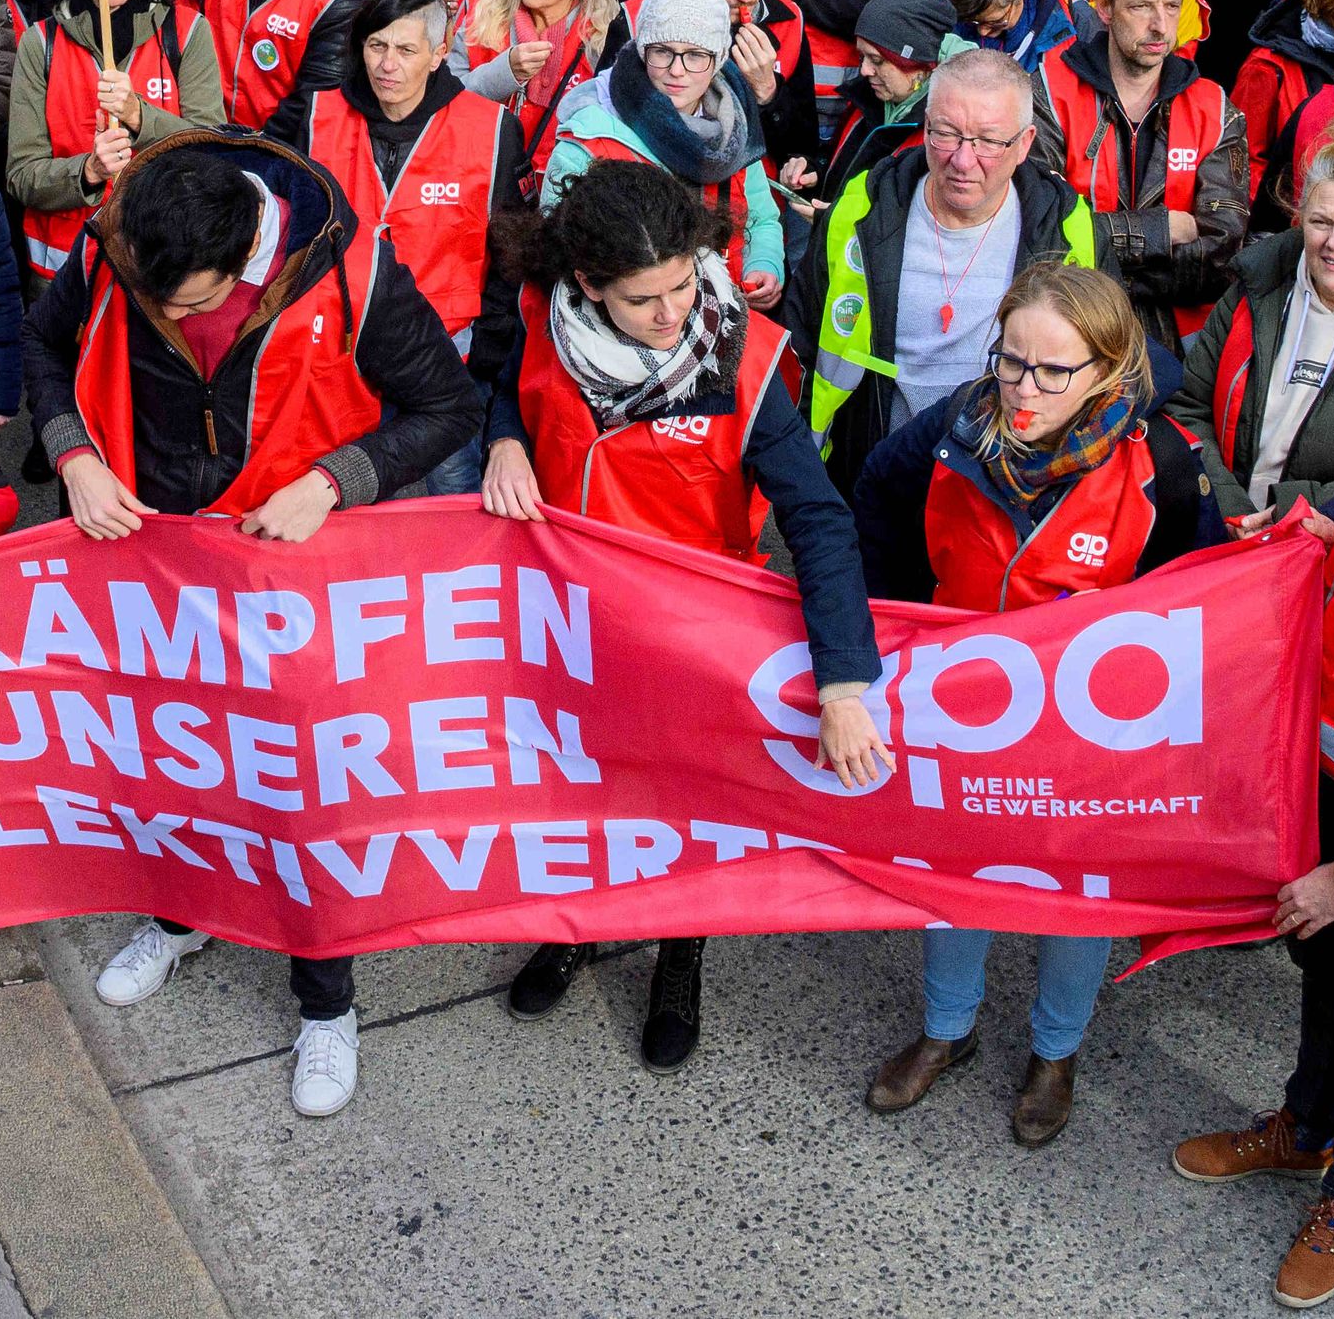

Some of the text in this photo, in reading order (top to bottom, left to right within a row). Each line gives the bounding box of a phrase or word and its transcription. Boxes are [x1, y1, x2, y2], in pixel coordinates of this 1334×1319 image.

[266, 14, 300, 35] gpa
[420, 182, 461, 205] gpa
[747, 605, 1206, 813] gpa
[961, 776, 1054, 796] MEINE
[961, 795, 1203, 817] GEWERKSCHAFT
